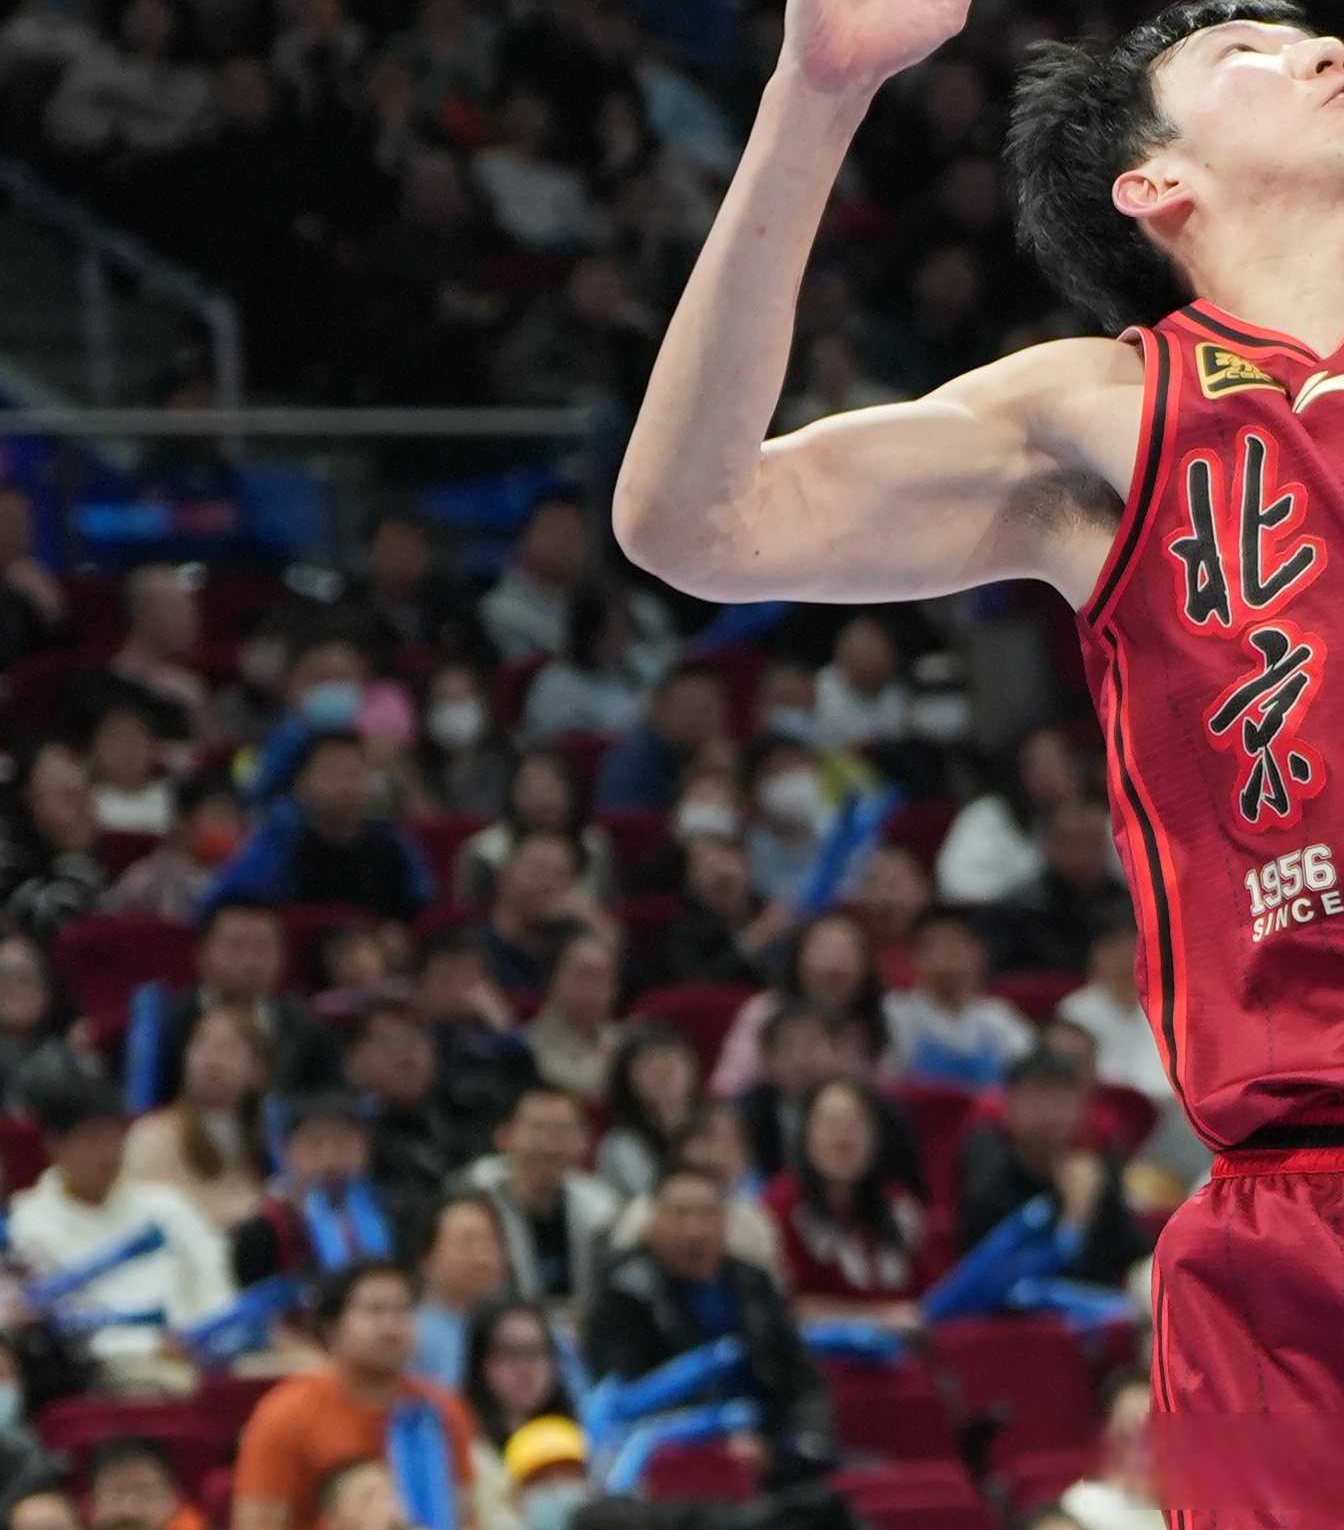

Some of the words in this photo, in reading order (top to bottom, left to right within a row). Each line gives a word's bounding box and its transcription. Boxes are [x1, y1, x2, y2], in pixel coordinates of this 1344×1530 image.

[1168, 429, 1324, 828] 北京
[1243, 843, 1338, 917] 1956
[1251, 890, 1344, 944] SINCE
